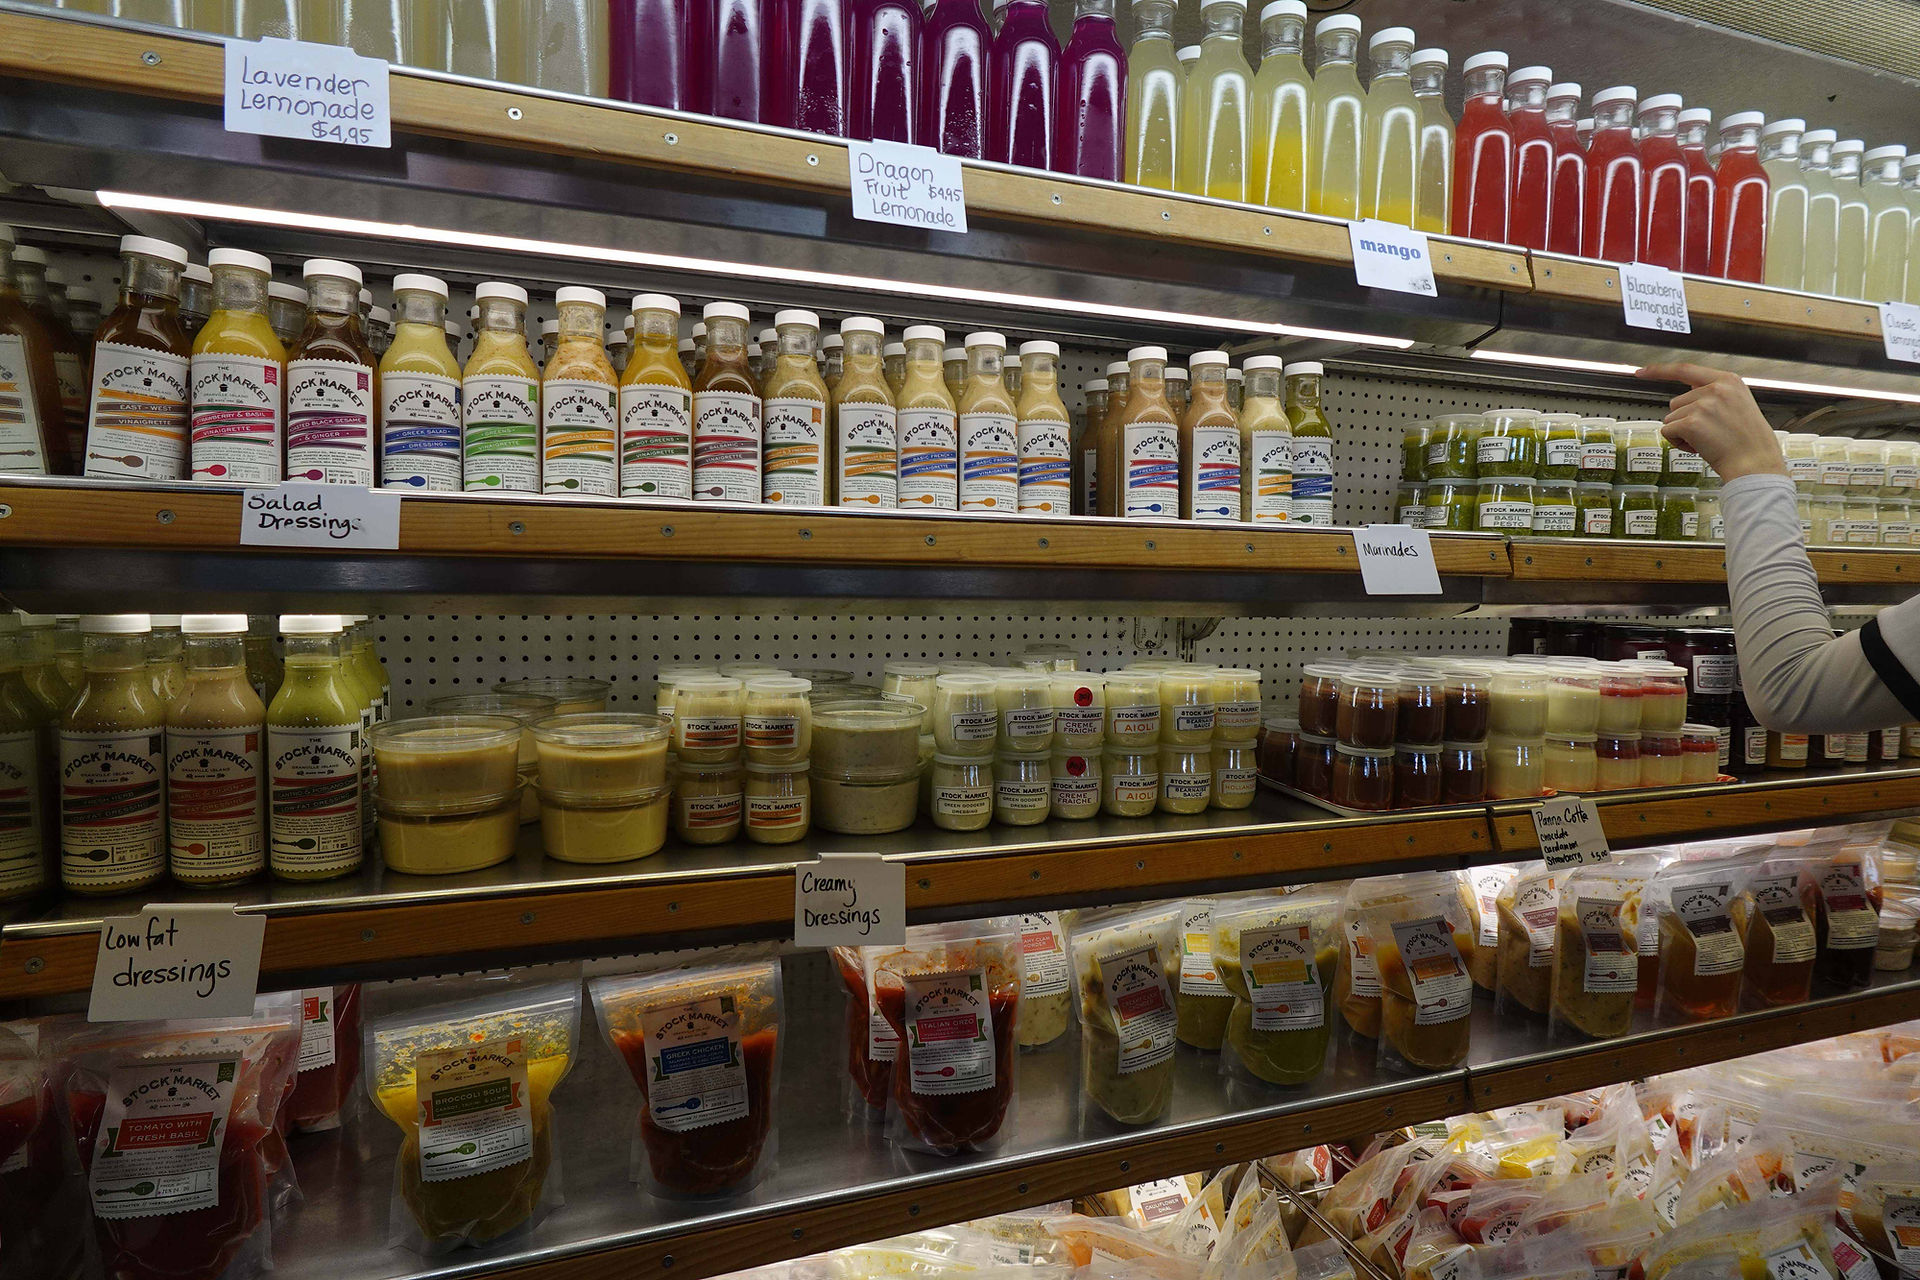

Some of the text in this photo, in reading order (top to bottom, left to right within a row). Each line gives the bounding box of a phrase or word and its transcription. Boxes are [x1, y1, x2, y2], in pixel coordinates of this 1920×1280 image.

[242, 55, 370, 96] Lavender
[241, 88, 374, 120] Lemonade
[858, 152, 934, 190] Dragon
[863, 178, 962, 201] Fruit $4.95
[872, 198, 956, 227] Lemonade
[1360, 239, 1421, 260] mango
[1628, 294, 1684, 318] Lemonade
[101, 366, 144, 387] STOCK
[223, 373, 271, 403] MARKET
[289, 378, 364, 408] STOCK MARKET
[389, 390, 460, 420] STOCK MARKET
[466, 390, 534, 418] STOCK MARKET
[548, 395, 614, 424] STOCK MARKET
[624, 400, 687, 427] STOCK MARKET
[118, 418, 172, 426] VINAIGRETTE
[202, 425, 251, 436] VINAIGRETTE
[311, 419, 334, 427] BLACK
[696, 407, 757, 434] STOCK MARKET
[782, 415, 817, 438] MARKET
[848, 419, 876, 440] STOCK
[311, 431, 340, 440] GINGER
[401, 429, 425, 437] GREEK
[903, 421, 931, 443] STOCK
[967, 426, 995, 447] STOCK
[478, 441, 519, 450] VINAIGRETTE
[1022, 433, 1049, 453] STOCK
[1133, 436, 1159, 455] STOCK
[1202, 440, 1228, 459] STOCK
[248, 493, 322, 511] Salad
[1362, 541, 1419, 557] Marinades
[1124, 723, 1154, 732] AIOLI
[64, 751, 157, 778] STOCK MARKET
[169, 747, 253, 773] STOCK MARKET
[275, 745, 356, 770] STOCK MARKET
[964, 791, 988, 799] MARKET
[1126, 792, 1154, 800] AIOLI
[1536, 803, 1589, 828] Panna Cotta
[801, 871, 857, 907] Creamy
[1681, 893, 1722, 914] STOCK MARKET
[804, 908, 881, 935] Dressings
[1185, 911, 1210, 928] STOCK
[1248, 938, 1306, 959] STOCK MARKET
[113, 957, 231, 998] dressings
[915, 987, 980, 1013] STOCK MARKET
[656, 1012, 728, 1041] STOCK MARKET
[921, 1018, 974, 1030] ITALIAN ORZO
[666, 1043, 725, 1060] GREEK CHICKEN
[430, 1054, 515, 1082] STOCK MARKET
[122, 1075, 221, 1107] STOCK MARKET
[435, 1086, 508, 1105] BROCCOLI SOUP
[129, 1120, 202, 1132] TOMATO WITH
[130, 1130, 200, 1143] FRESH BASIL
[1801, 1164, 1828, 1178] STOCK
[1144, 1198, 1180, 1211] CAULIFLOWER
[1488, 1222, 1506, 1241] STOCK
